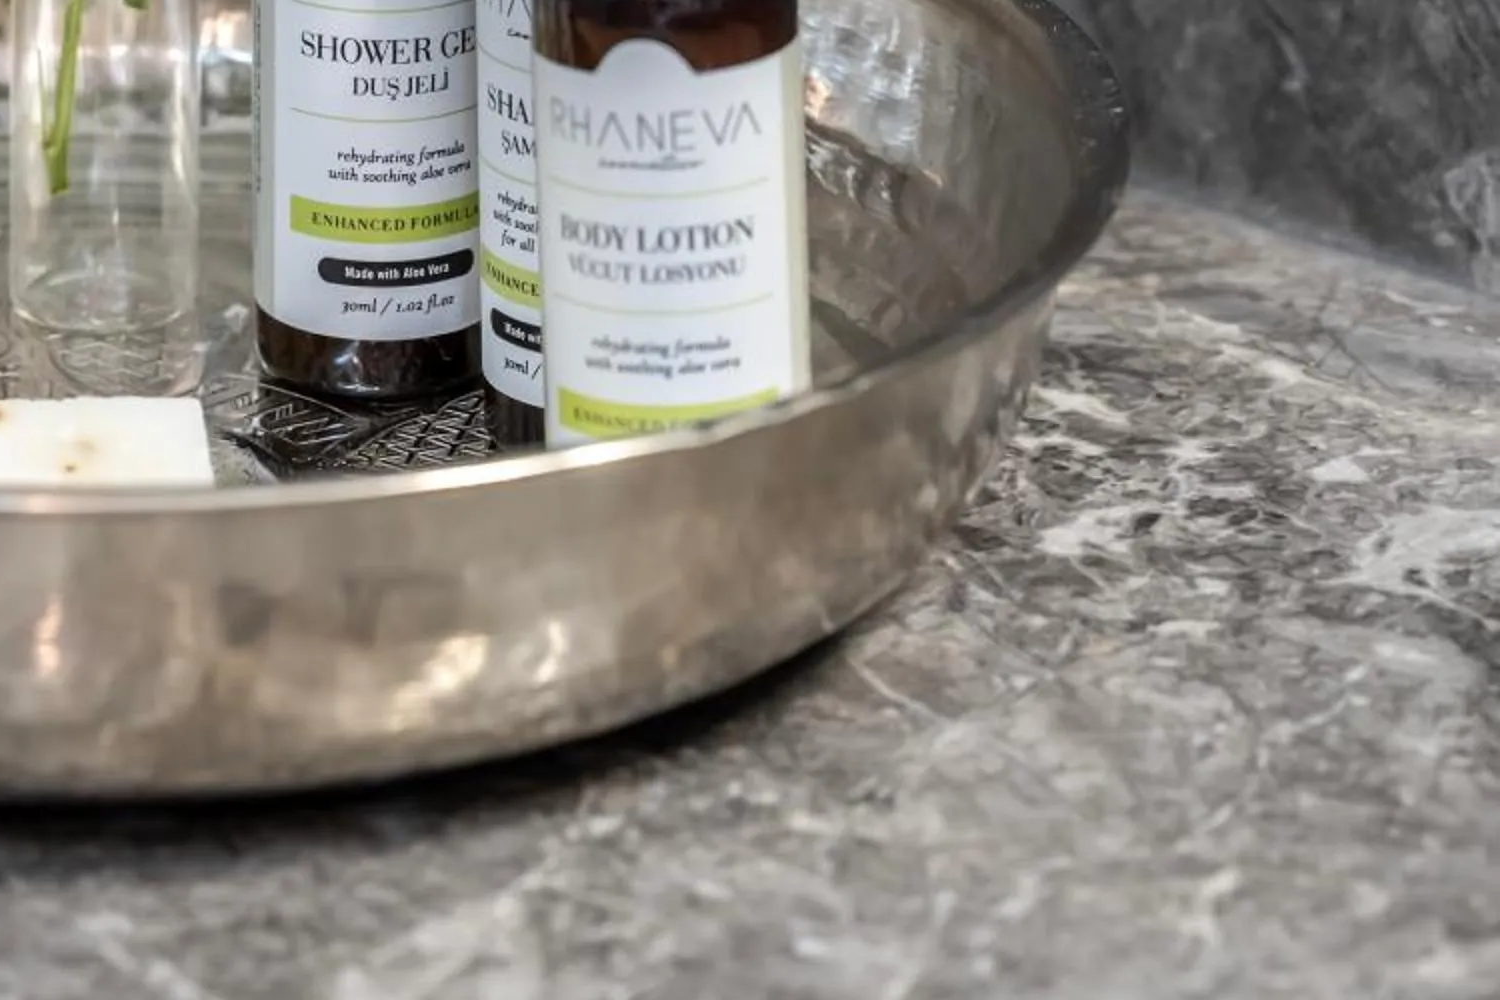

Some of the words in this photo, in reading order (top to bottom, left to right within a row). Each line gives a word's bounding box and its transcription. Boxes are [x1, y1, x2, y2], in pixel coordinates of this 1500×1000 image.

[300, 30, 432, 65] SHOWER
[441, 25, 476, 59] GE
[353, 75, 400, 101] DUŞ
[487, 82, 533, 126] SHA
[549, 95, 762, 151] RHANEVA
[337, 146, 415, 168] rehydrating
[418, 140, 465, 166] formula
[501, 129, 536, 159] ŞAM
[328, 167, 358, 182] with
[363, 167, 417, 186] soothing
[421, 165, 443, 181] aloe
[447, 159, 471, 175] vera
[311, 210, 405, 232] ENHANCED
[560, 212, 628, 251] BODY
[636, 214, 756, 253] LOTION
[501, 229, 516, 246] for
[519, 237, 534, 253] all
[345, 265, 375, 279] Made
[377, 266, 400, 280] with
[403, 265, 425, 279] Aloe
[428, 262, 449, 276] Vera
[486, 261, 539, 297] ENHANCE
[640, 252, 747, 284] LOSYONU
[341, 298, 377, 315] 30ml
[380, 297, 393, 315] /
[396, 301, 424, 313] 1.02
